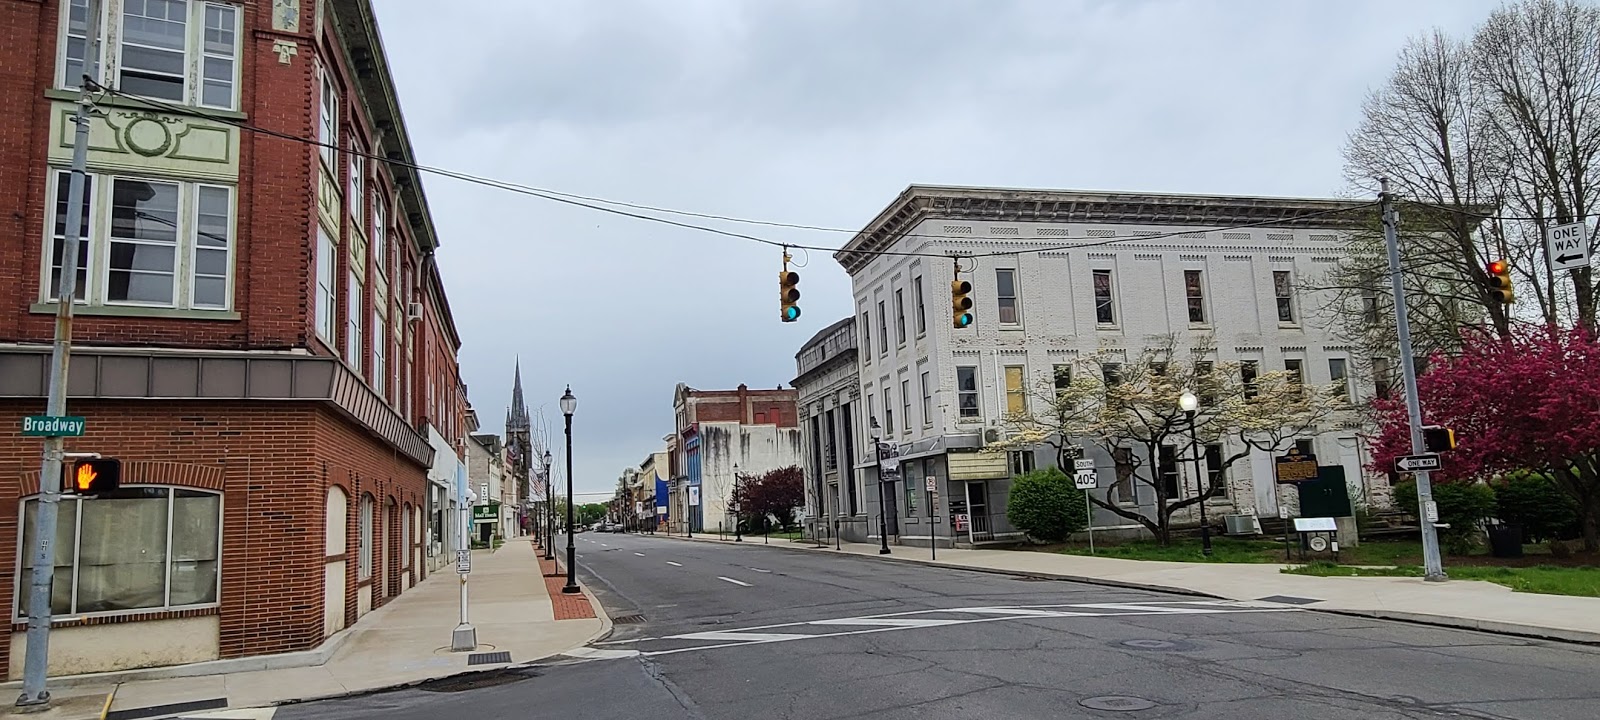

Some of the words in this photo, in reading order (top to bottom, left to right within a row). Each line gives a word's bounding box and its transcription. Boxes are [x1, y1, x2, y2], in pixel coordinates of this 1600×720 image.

[1553, 226, 1580, 240] ONE
[1555, 238, 1581, 251] WAY
[23, 416, 83, 436] Broadway
[1077, 473, 1096, 485] 405
